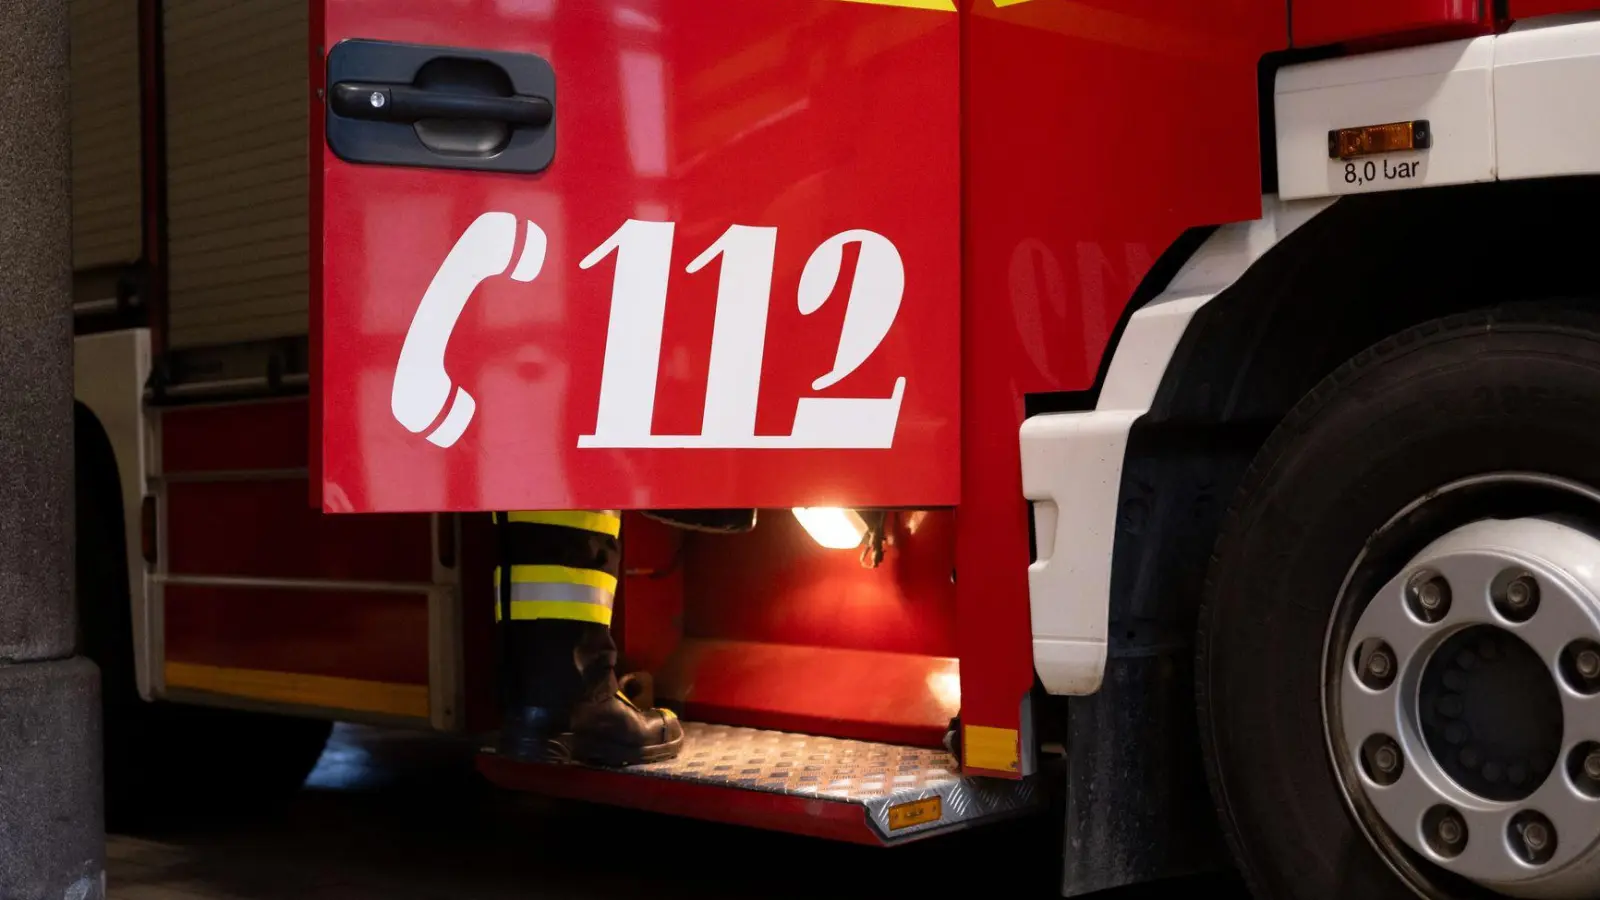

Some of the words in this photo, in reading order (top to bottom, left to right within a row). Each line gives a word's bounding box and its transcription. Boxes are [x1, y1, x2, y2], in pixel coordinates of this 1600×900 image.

[1344, 161, 1376, 186] 8,0
[1383, 160, 1420, 179] bar
[577, 219, 906, 449] 112
